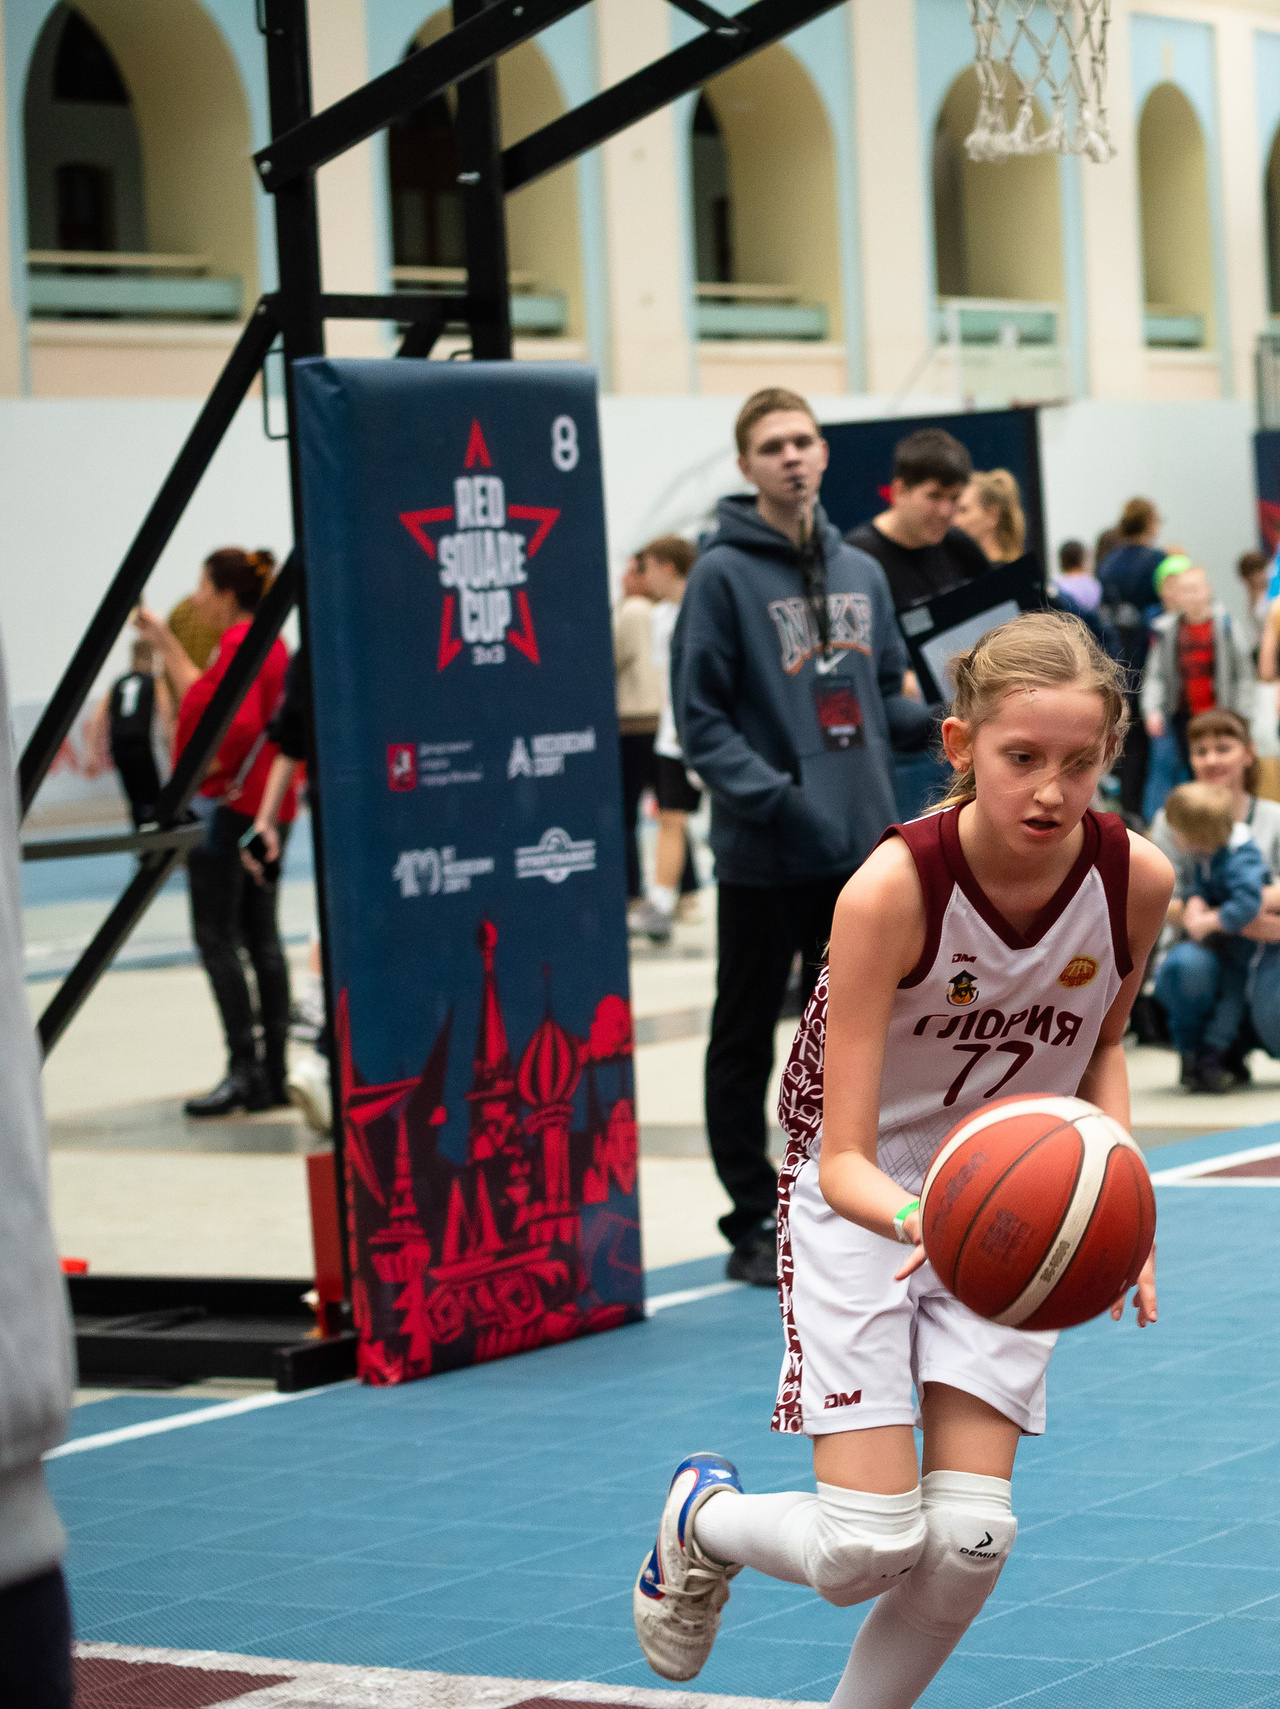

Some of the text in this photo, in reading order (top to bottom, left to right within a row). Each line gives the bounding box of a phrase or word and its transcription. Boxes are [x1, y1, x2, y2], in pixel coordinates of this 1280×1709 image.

[552, 414, 580, 472] 8
[454, 474, 506, 530] RED
[438, 530, 528, 590] SQUARE
[459, 587, 512, 644] CUP
[913, 1005, 1083, 1046] ГЛОРИЯ
[943, 1040, 1034, 1107] 77
[823, 1389, 862, 1410] DM
[959, 1547, 1000, 1559] DEMIX
